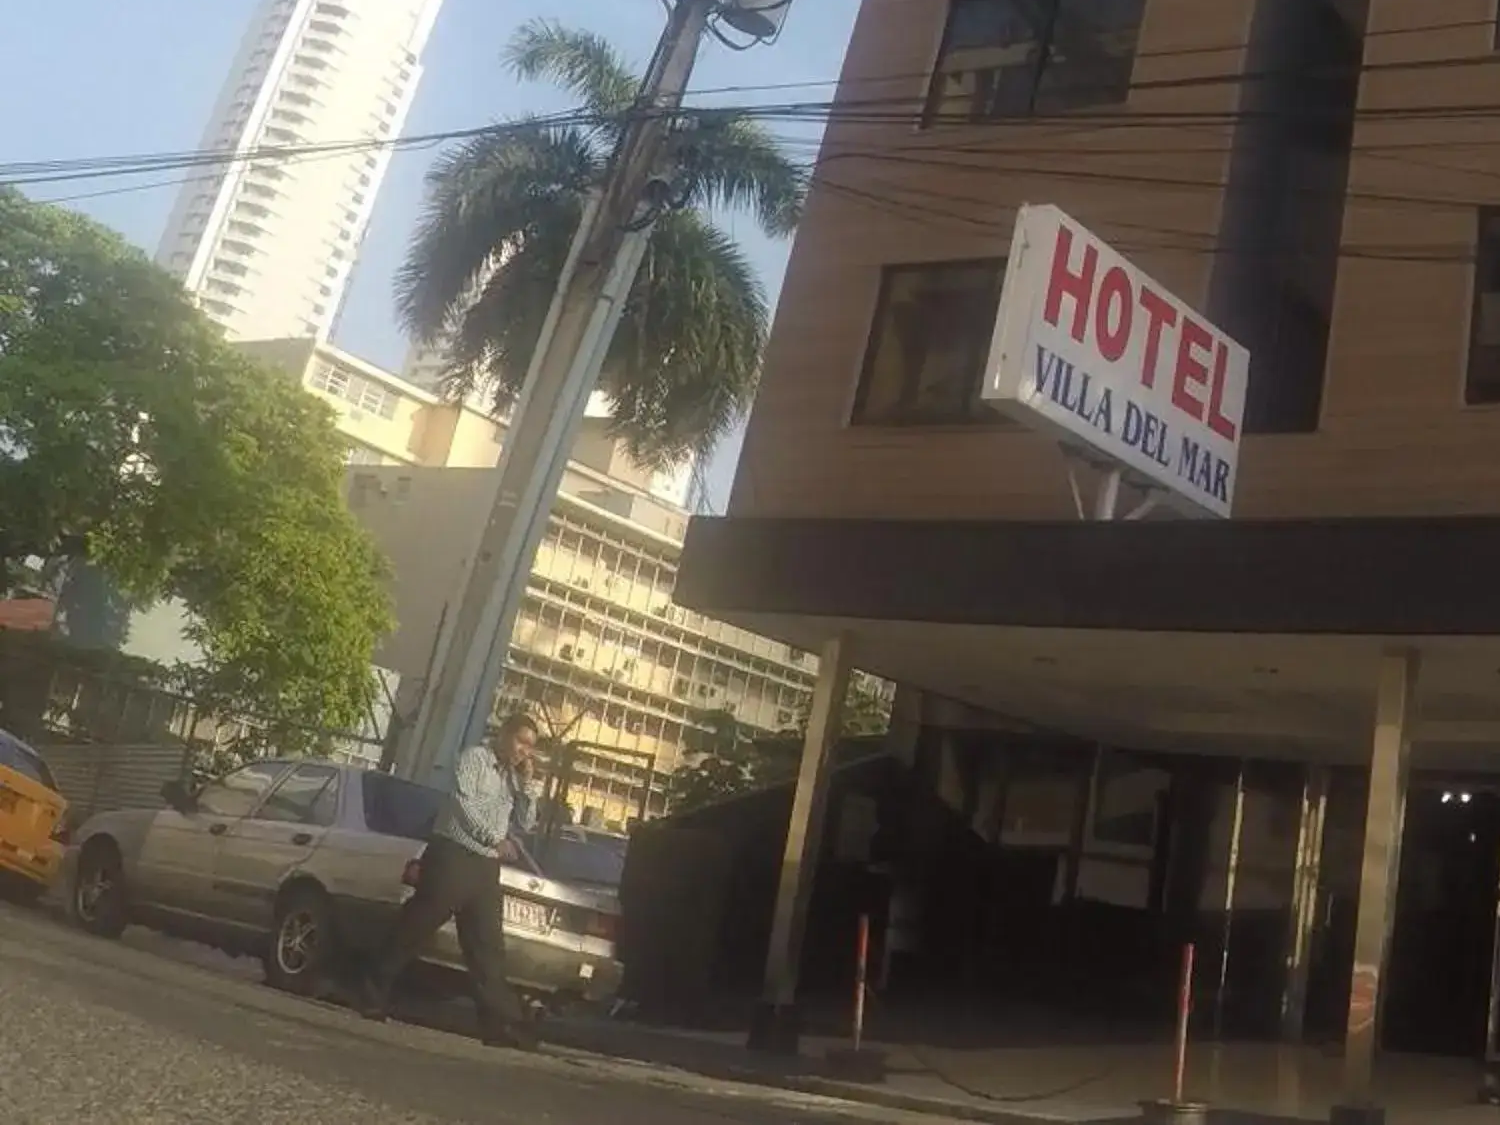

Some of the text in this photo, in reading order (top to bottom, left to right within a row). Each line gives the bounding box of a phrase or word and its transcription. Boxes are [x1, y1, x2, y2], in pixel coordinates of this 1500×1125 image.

[1034, 344, 1231, 503] VILLA DEL MAR
[1043, 225, 1236, 441] HOTEL
